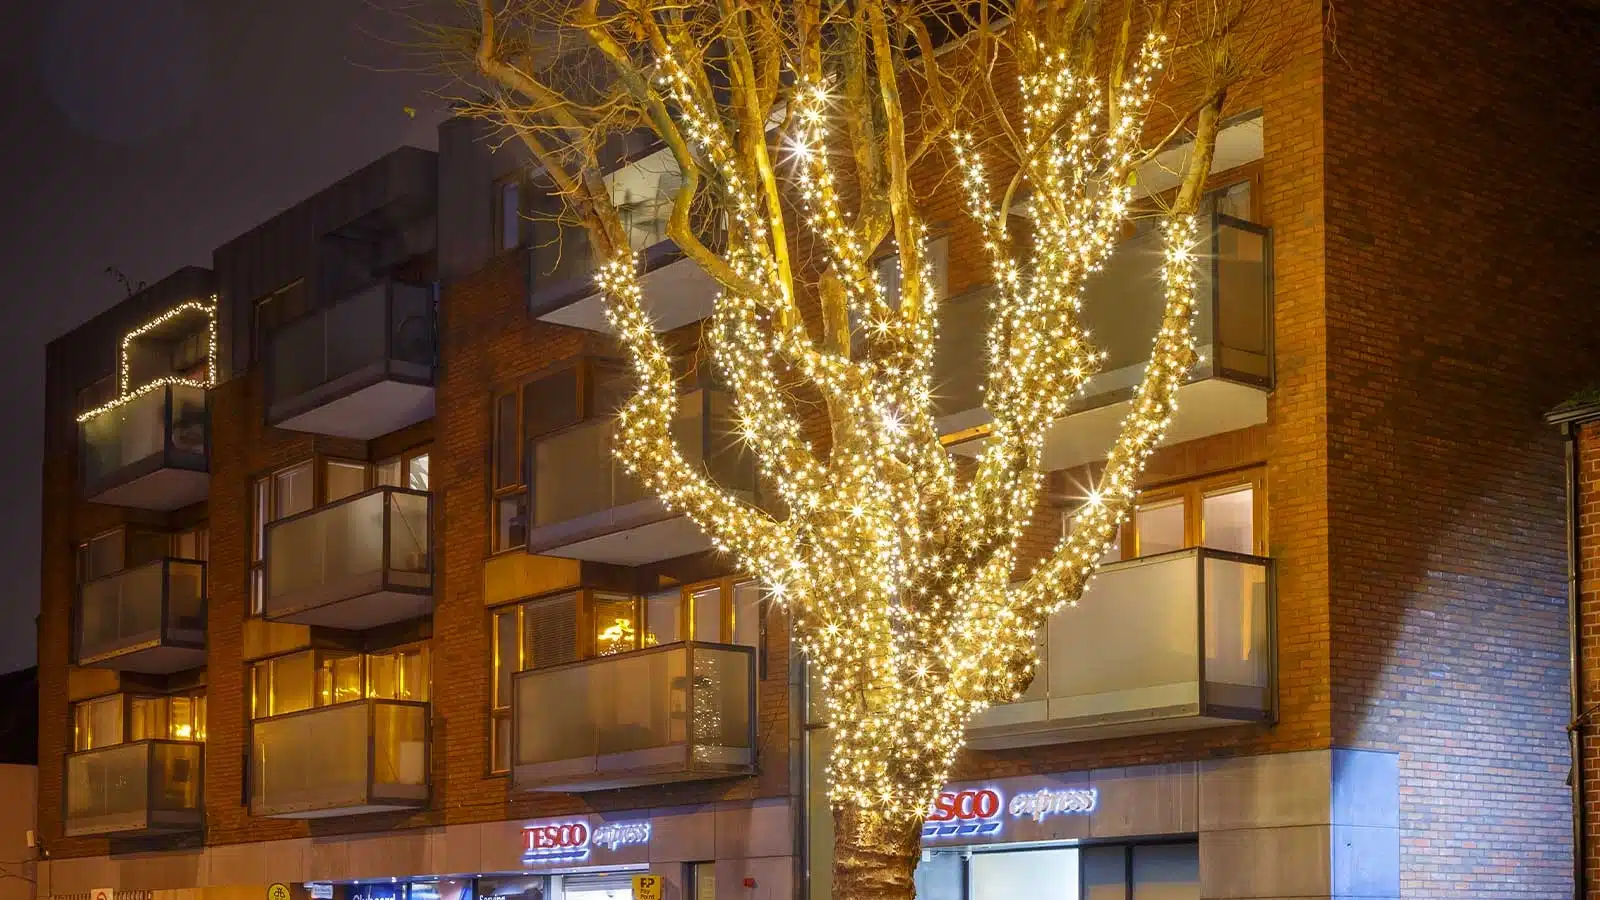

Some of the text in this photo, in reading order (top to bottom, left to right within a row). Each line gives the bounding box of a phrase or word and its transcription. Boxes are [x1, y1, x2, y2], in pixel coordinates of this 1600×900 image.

[925, 789, 1096, 822] SCO express
[520, 823, 650, 850] TESCO express
